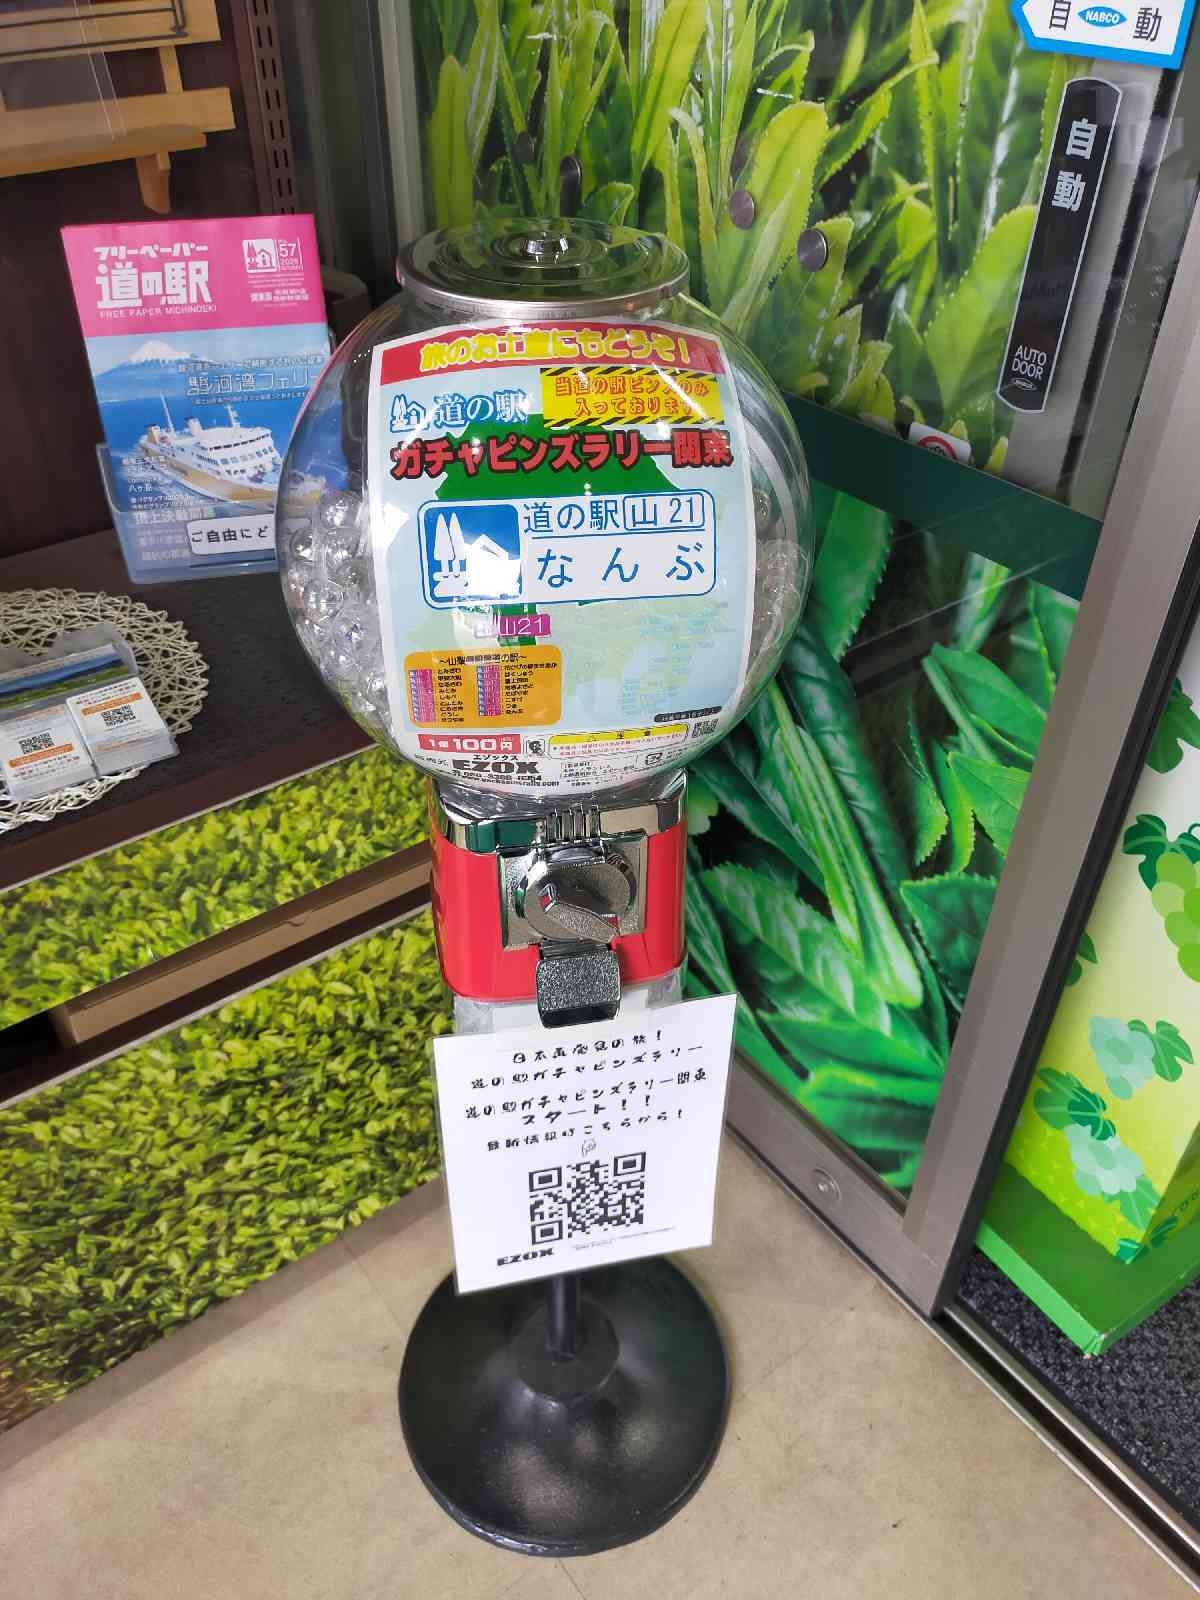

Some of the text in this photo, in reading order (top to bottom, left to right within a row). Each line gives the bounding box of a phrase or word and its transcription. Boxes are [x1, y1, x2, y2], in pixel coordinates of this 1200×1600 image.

[1049, 0, 1162, 42] 自 NABCO 動
[1051, 117, 1098, 212] 自動
[94, 243, 209, 261] フリーペーパー
[279, 243, 297, 257] 57
[96, 261, 213, 309] 道の駅
[100, 310, 126, 318] FREE
[130, 308, 163, 317] PAPER
[1011, 358, 1043, 380] DOOR
[1015, 345, 1047, 366] AUTO
[434, 390, 528, 428] 道の駅
[390, 427, 736, 481] ガチャピンズラリー関東
[523, 500, 620, 533] 道の駅
[536, 541, 706, 588] なんぶ
[452, 759, 540, 774] EZOX
